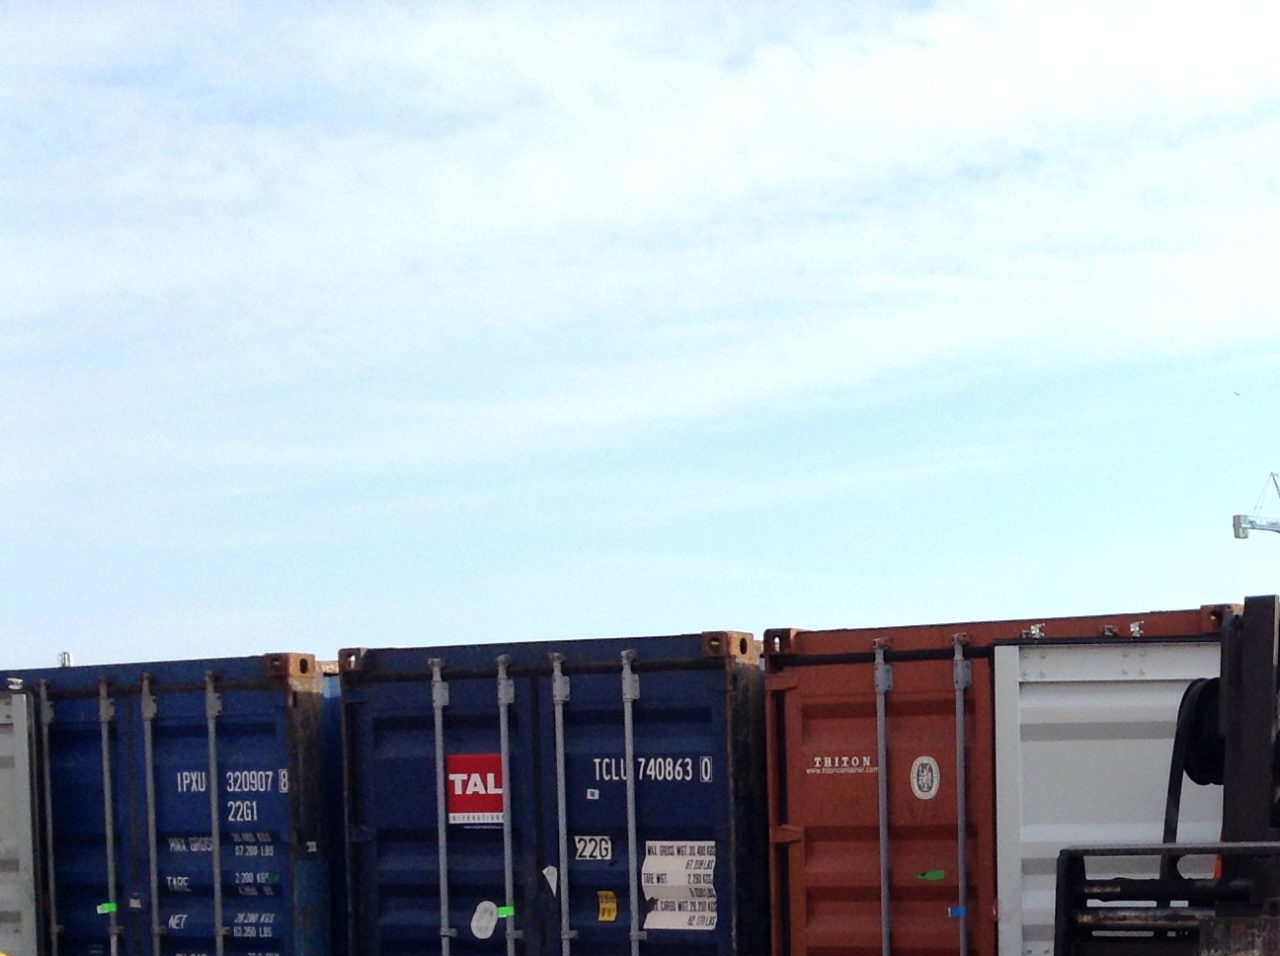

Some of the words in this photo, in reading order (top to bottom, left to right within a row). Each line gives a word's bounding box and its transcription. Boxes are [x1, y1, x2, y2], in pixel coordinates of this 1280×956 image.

[637, 757, 693, 781] 740863
[700, 756, 713, 782] 0
[813, 757, 871, 767] TRITON
[177, 771, 207, 793] IPXU
[225, 770, 273, 792] 320907
[278, 768, 289, 793] 8
[448, 772, 504, 795] TAL
[227, 800, 258, 821] 22G1
[577, 837, 610, 860] 22G
[168, 914, 188, 930] NET
